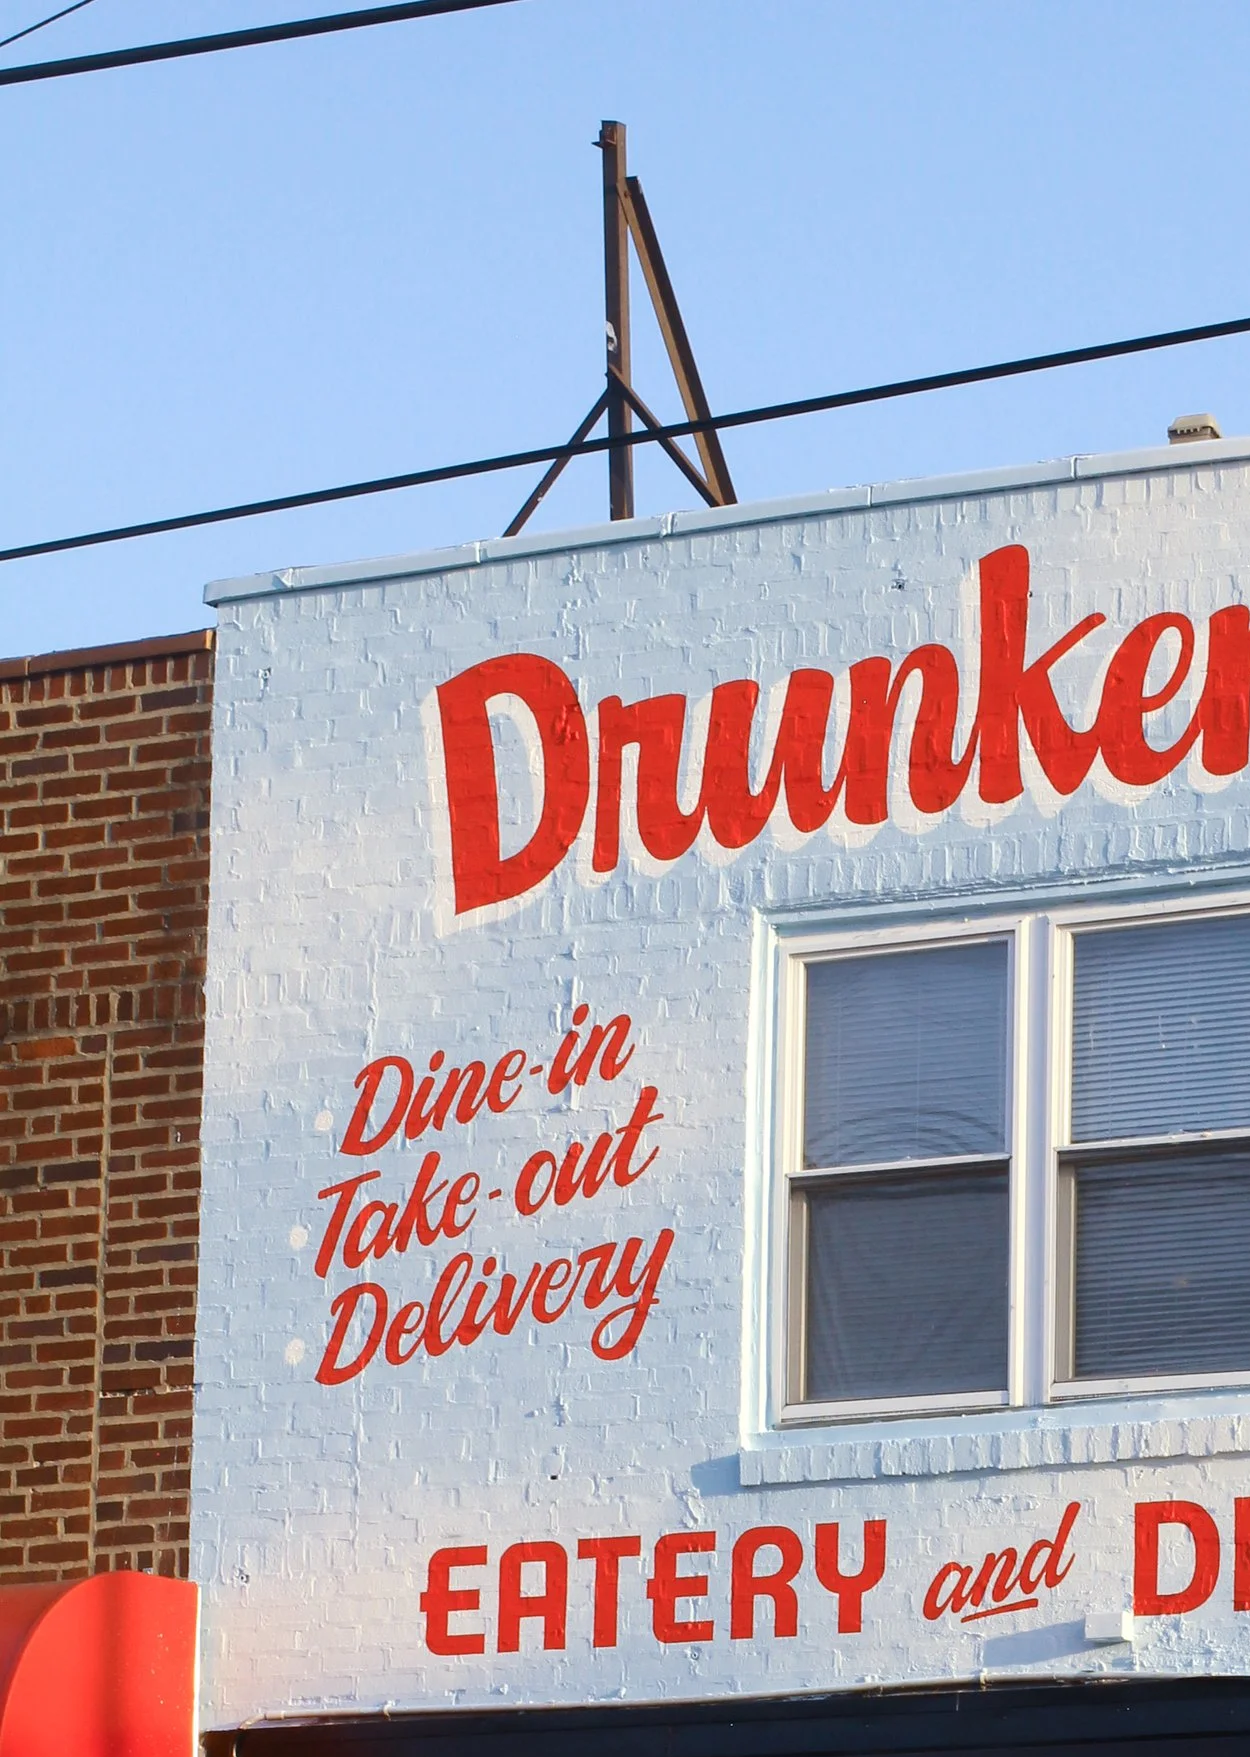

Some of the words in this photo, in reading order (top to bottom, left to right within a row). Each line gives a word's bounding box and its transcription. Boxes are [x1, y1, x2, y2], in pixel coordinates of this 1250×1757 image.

[340, 1003, 636, 1157] Dine-in
[314, 1086, 665, 1279] Take-out
[314, 1228, 675, 1386] Delivery
[420, 1519, 888, 1657] EATERY
[922, 1501, 1082, 1623] and
